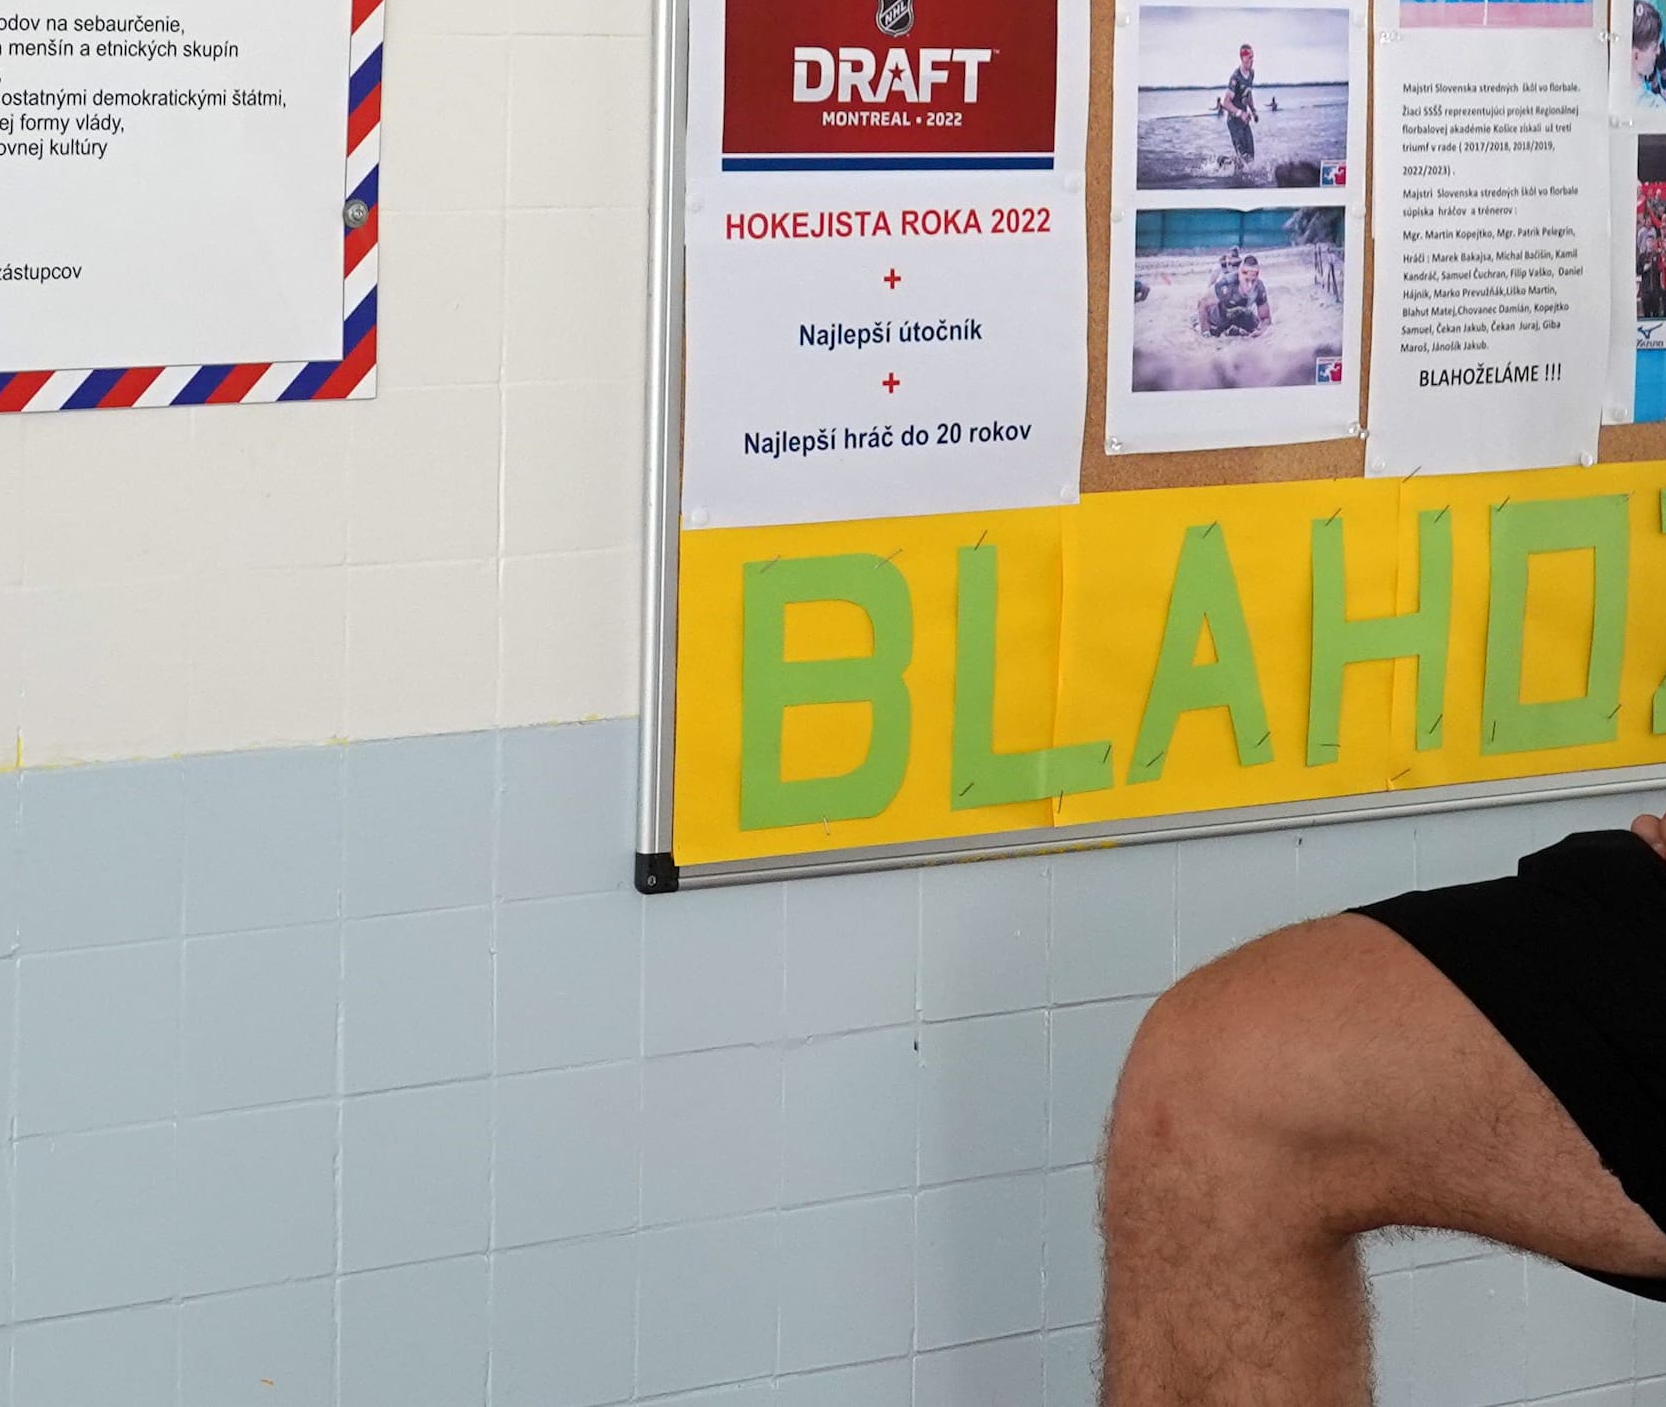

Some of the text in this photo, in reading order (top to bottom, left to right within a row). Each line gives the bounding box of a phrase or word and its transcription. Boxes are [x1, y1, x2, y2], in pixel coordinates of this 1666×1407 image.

[793, 47, 991, 103] DRAFT
[1435, 82, 1477, 94] Slovenska
[823, 111, 962, 127] MONTREAL 2022
[50, 137, 108, 160] kultúry
[727, 207, 1050, 241] HOKEJISTA ROKA 2022
[800, 318, 982, 351] Najlepší útočník
[1419, 360, 1540, 388] BLAHOŽELÁME
[745, 420, 1032, 459] Najlepší hráč do 20 rokov
